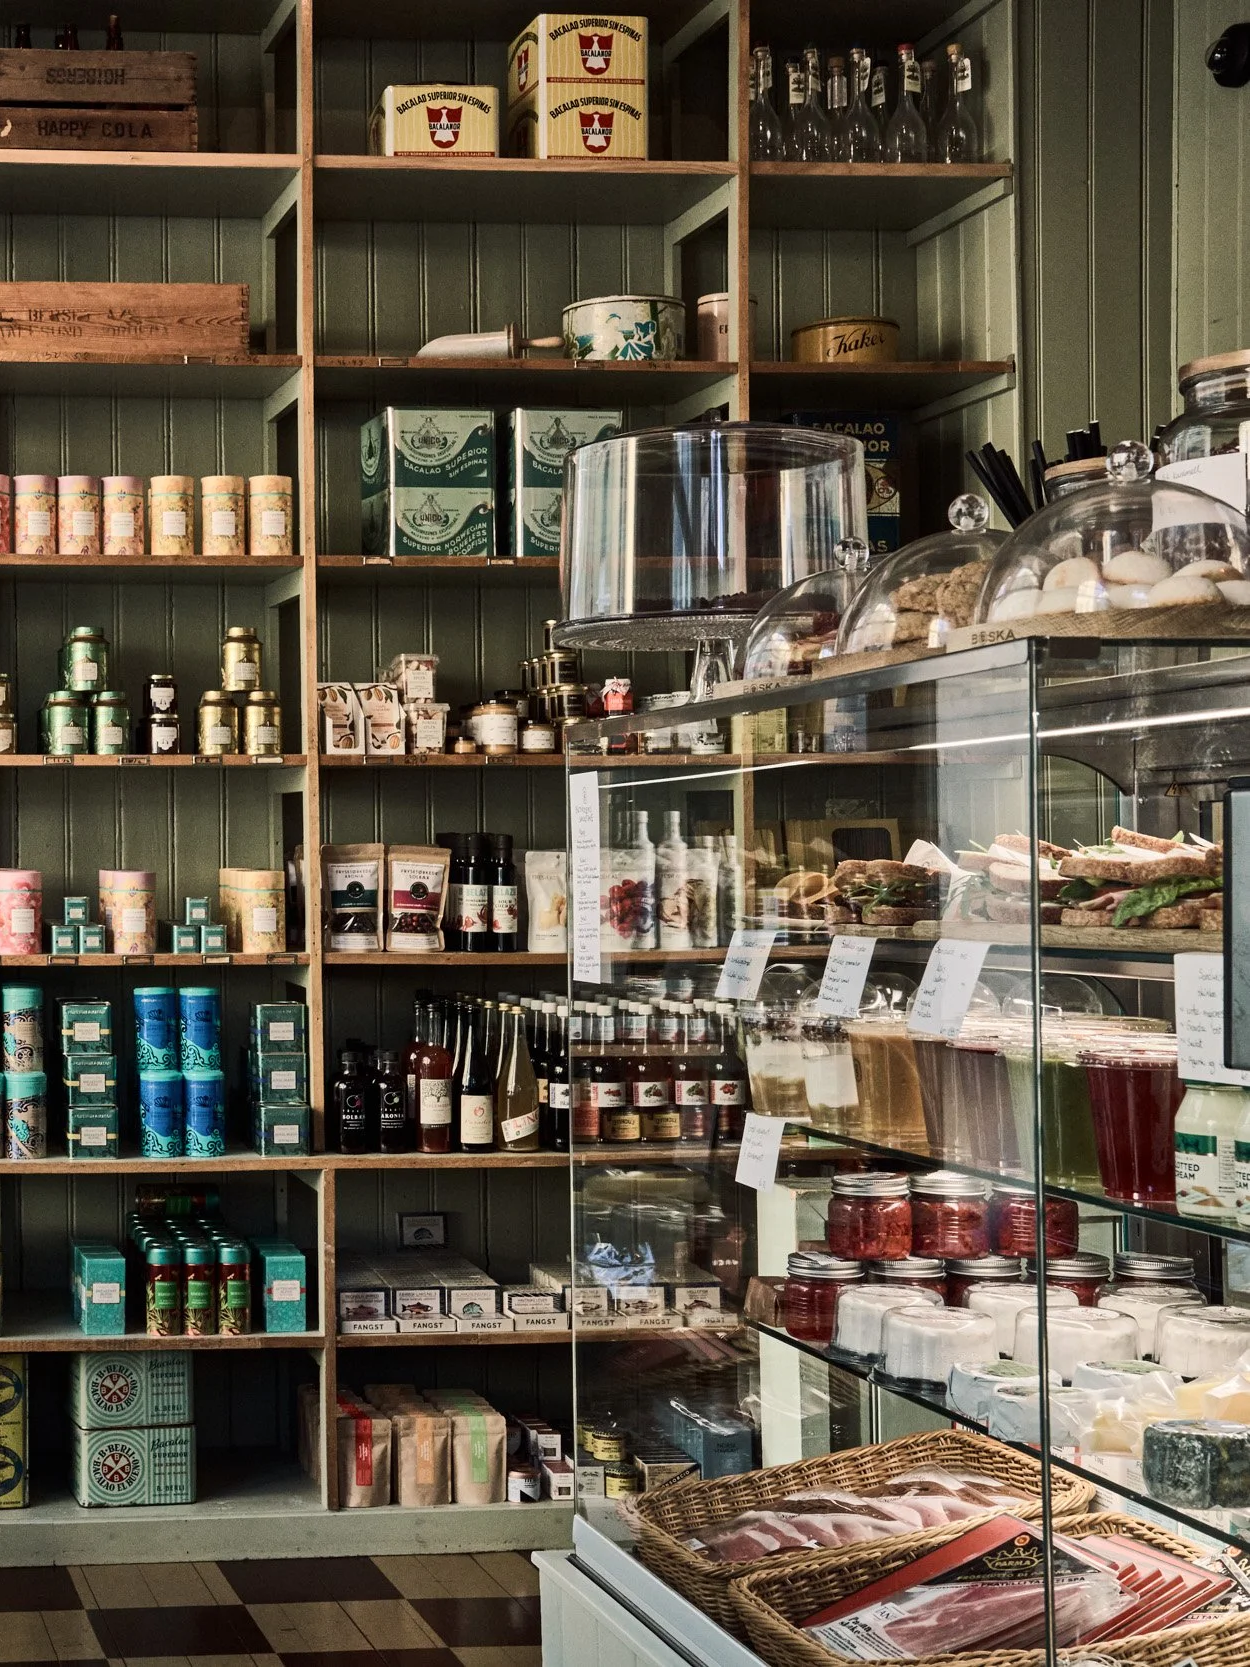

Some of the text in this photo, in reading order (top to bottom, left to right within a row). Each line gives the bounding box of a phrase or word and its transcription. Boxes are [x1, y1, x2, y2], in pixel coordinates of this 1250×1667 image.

[549, 18, 642, 42] BACALAO SUPERIOR SIN ESPINAS
[396, 91, 492, 115] BACALAO SUPERIOR SIN ESPINAS
[550, 96, 642, 120] BACALAO SUPERIOR SIN ESPINAS
[36, 121, 153, 139] HAPPY COLA
[826, 326, 886, 358] Kaker
[404, 447, 488, 474] BACALAO SUPERIOR
[448, 458, 488, 478] SIN ESPINAS
[532, 460, 564, 474] BACALA
[402, 522, 488, 552] SUPERIOR NORWEGIAN
[107, 1364, 130, 1380] BERLI
[91, 1381, 138, 1413] BACALAO EL BUENO
[108, 1444, 133, 1459] BERLI
[92, 1461, 115, 1492] BACALAO
[124, 1459, 140, 1488] BUENO
[957, 1572, 1013, 1580] PROSCIUTTO
[995, 1560, 1031, 1568] PARMA
